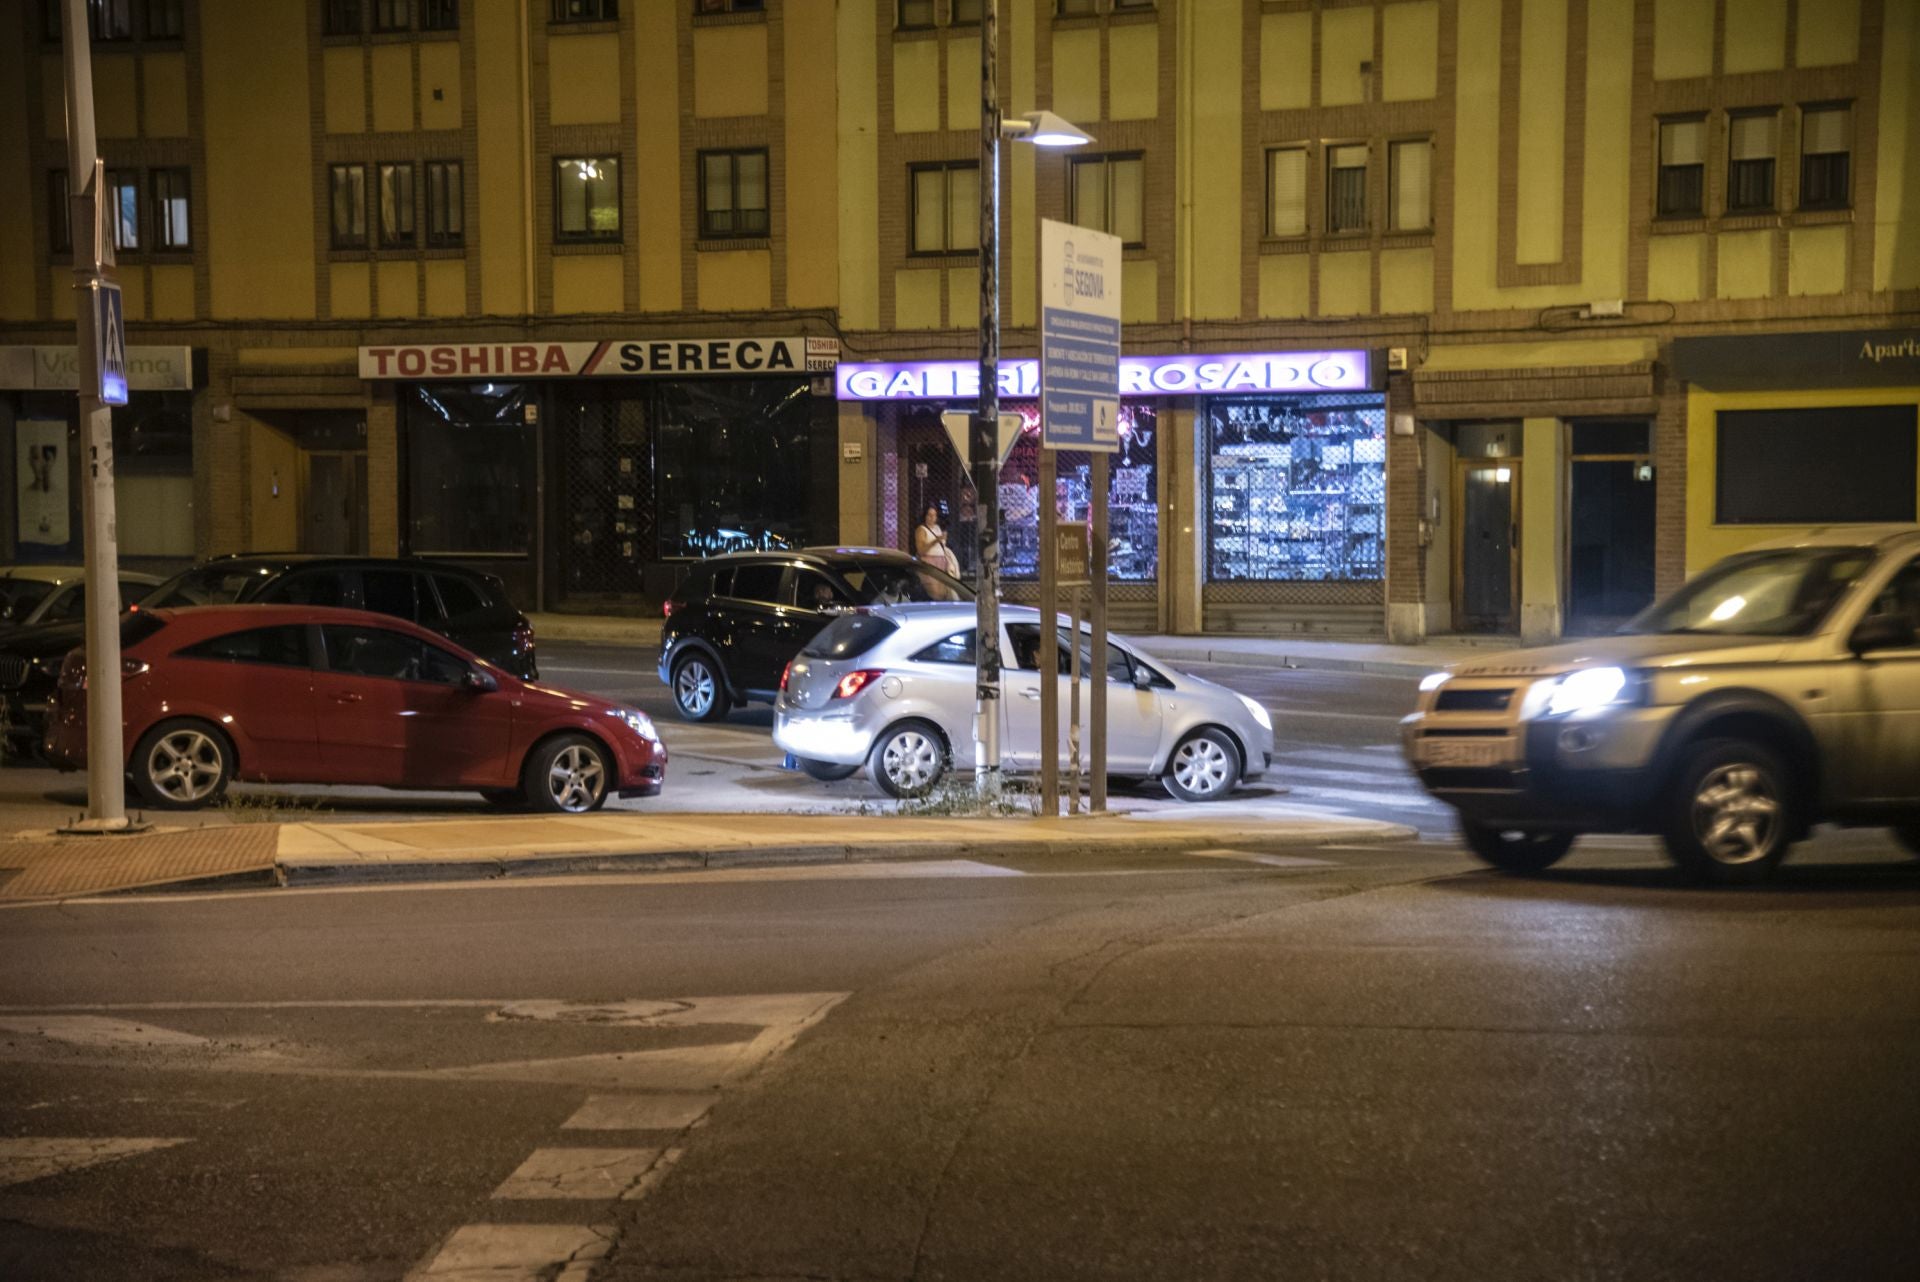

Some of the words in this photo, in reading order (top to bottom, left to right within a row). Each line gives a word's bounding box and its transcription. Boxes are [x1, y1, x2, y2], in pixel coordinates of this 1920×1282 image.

[1075, 269, 1104, 300] SEGOVIA
[368, 345, 571, 376] TOSHIBA
[620, 341, 794, 372] SERECA
[808, 339, 838, 350] TOSHIBA
